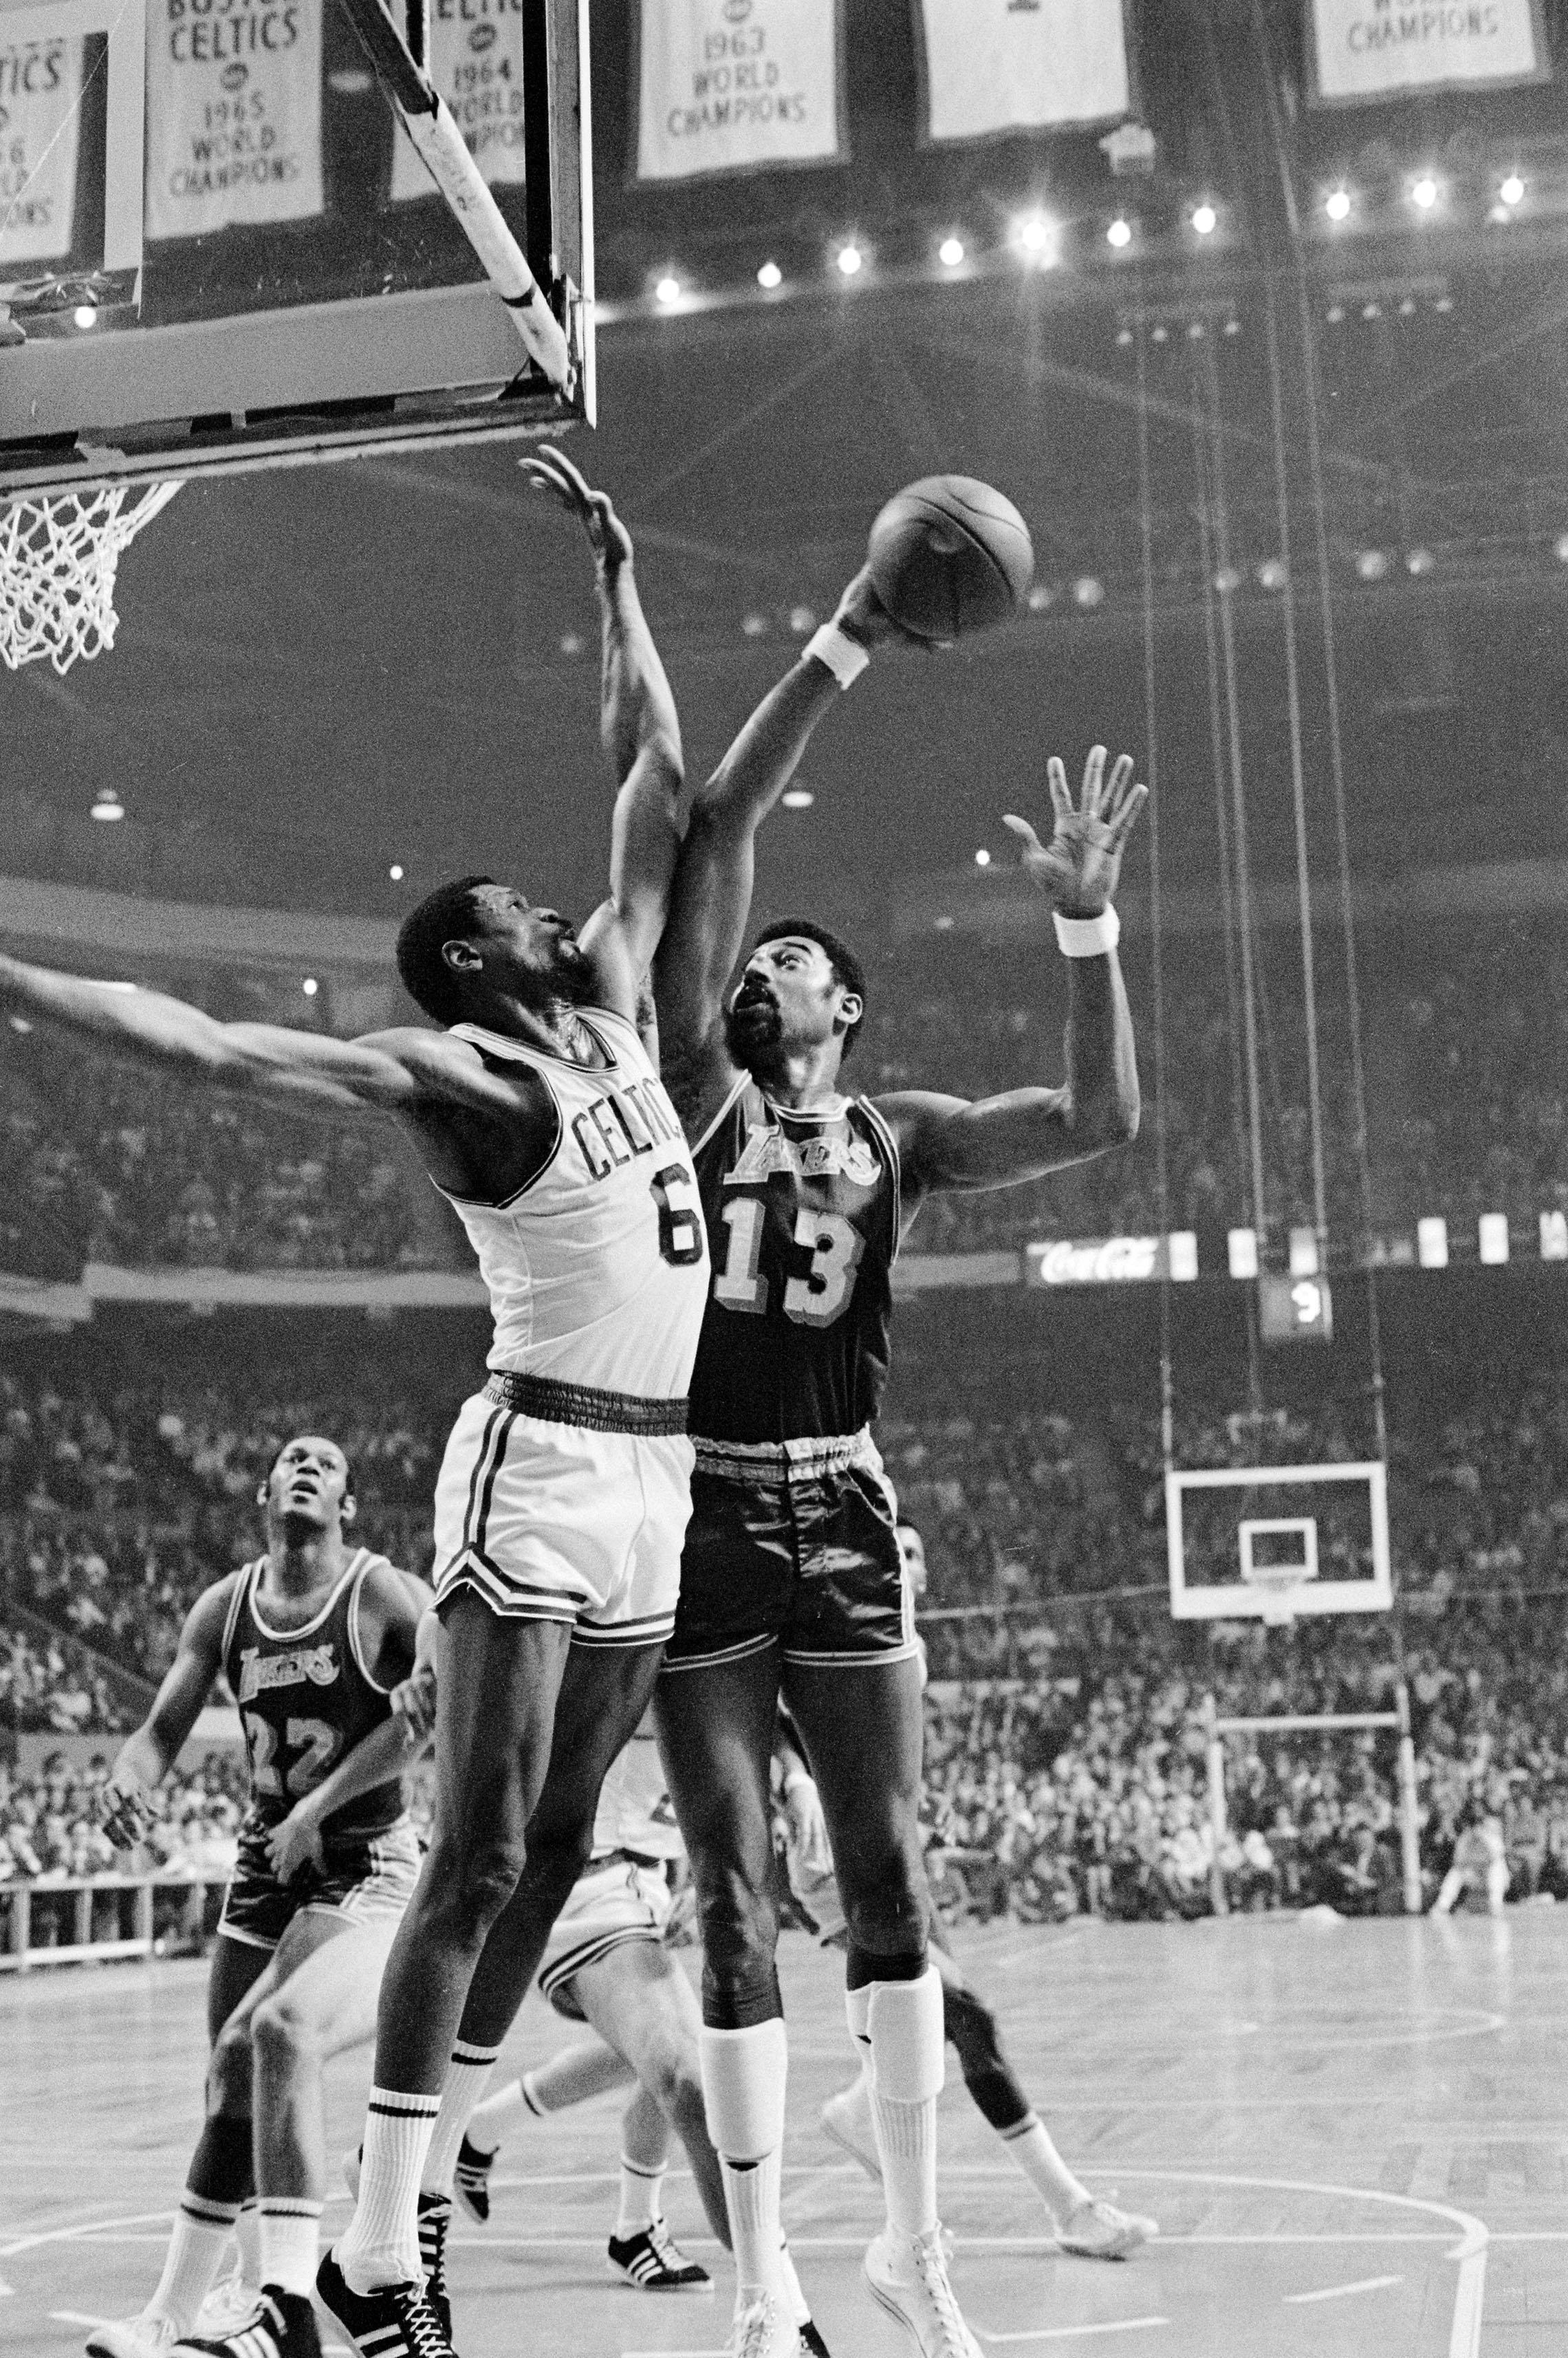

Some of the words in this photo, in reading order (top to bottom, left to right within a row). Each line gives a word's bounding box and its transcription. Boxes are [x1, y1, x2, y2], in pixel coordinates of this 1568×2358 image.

[169, 6, 298, 63] CELTICS
[704, 25, 765, 63] 1963
[1347, 5, 1499, 54] CHAMPIONS
[454, 58, 512, 93] 1964
[692, 61, 779, 98] WORLD
[205, 90, 265, 129] 1965
[667, 94, 807, 138] CHAMPIONS
[191, 125, 276, 162] WORLD
[169, 155, 300, 196] CHAMPIONS
[571, 1077, 688, 1182] CELTIC
[649, 1162, 703, 1268] 6
[714, 1197, 866, 1329] 13
[1290, 1281, 1322, 1323] 9
[244, 1710, 345, 1797] 22
